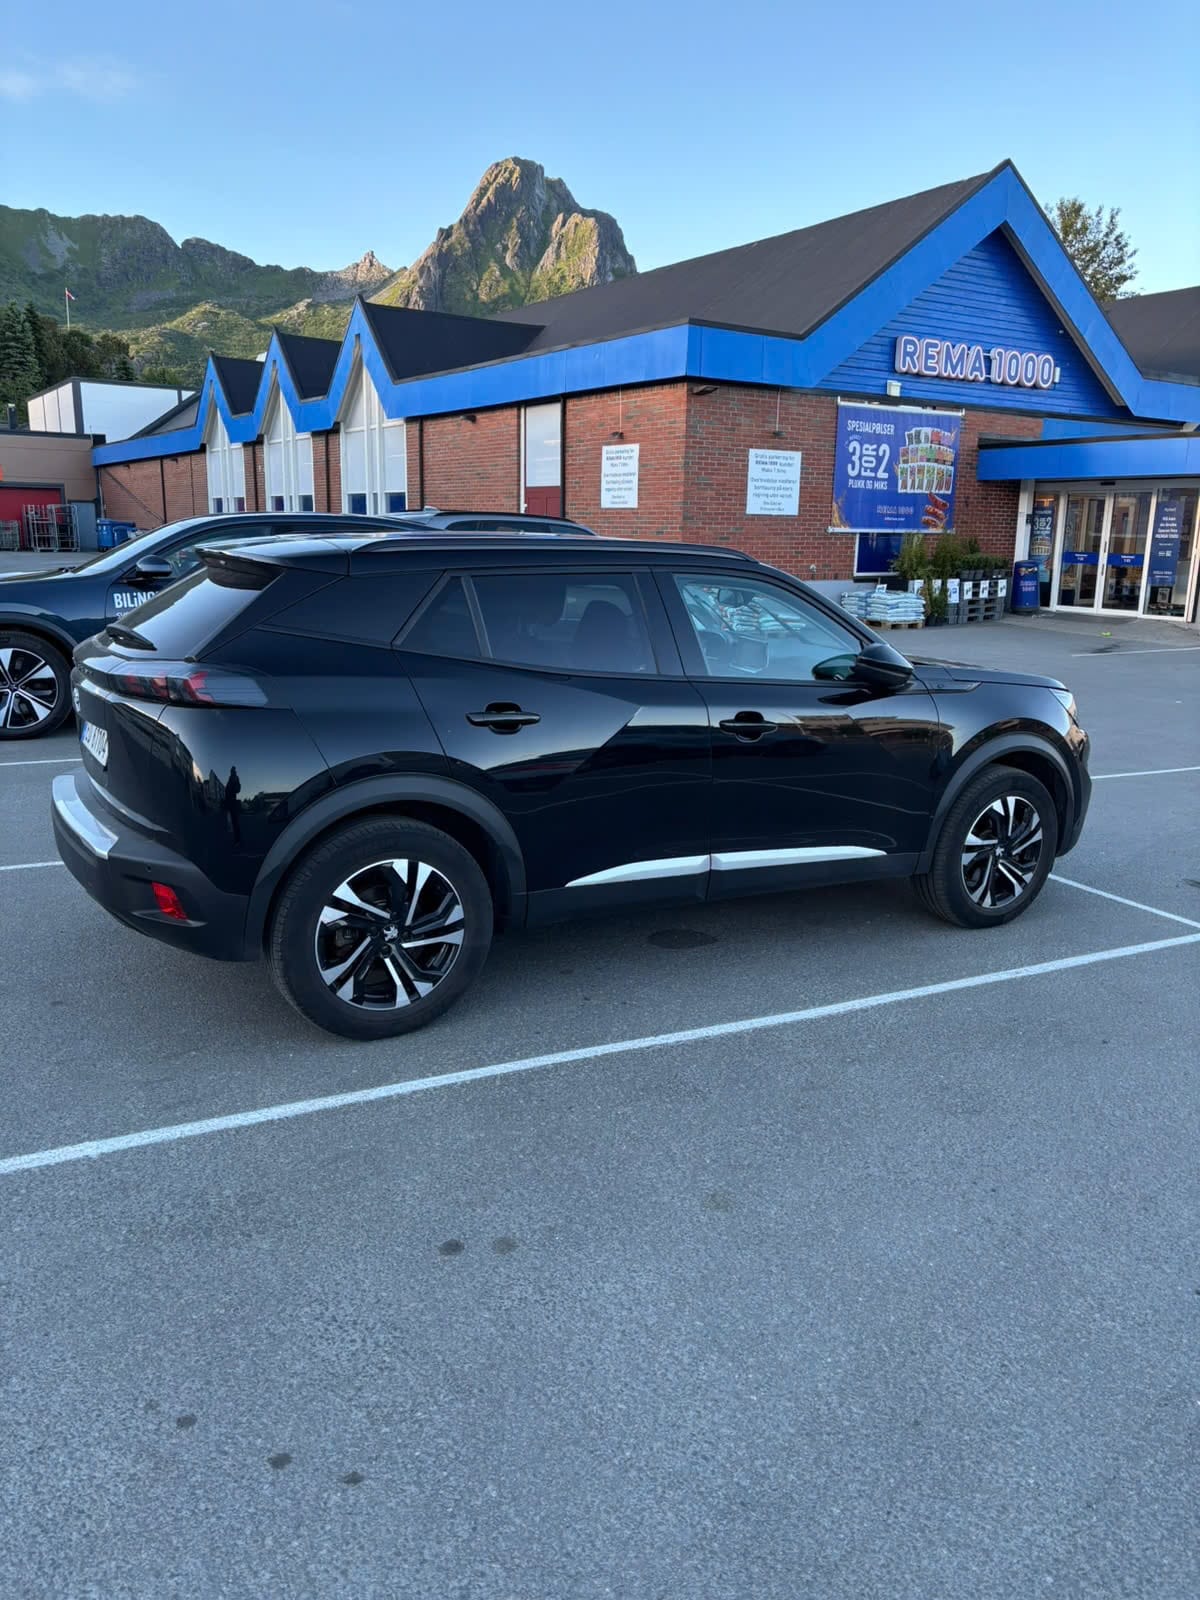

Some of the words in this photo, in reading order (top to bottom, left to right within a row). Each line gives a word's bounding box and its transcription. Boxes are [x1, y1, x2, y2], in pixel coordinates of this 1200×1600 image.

[896, 336, 986, 381] REMA
[990, 348, 1055, 389] 1000
[846, 419, 895, 435] SPESIALPØLSER
[847, 440, 861, 477] 3
[861, 443, 877, 478] FOR
[877, 443, 890, 479] 2
[848, 479, 865, 489] PLUKK
[866, 480, 873, 489] OG
[874, 480, 888, 490] MIKS
